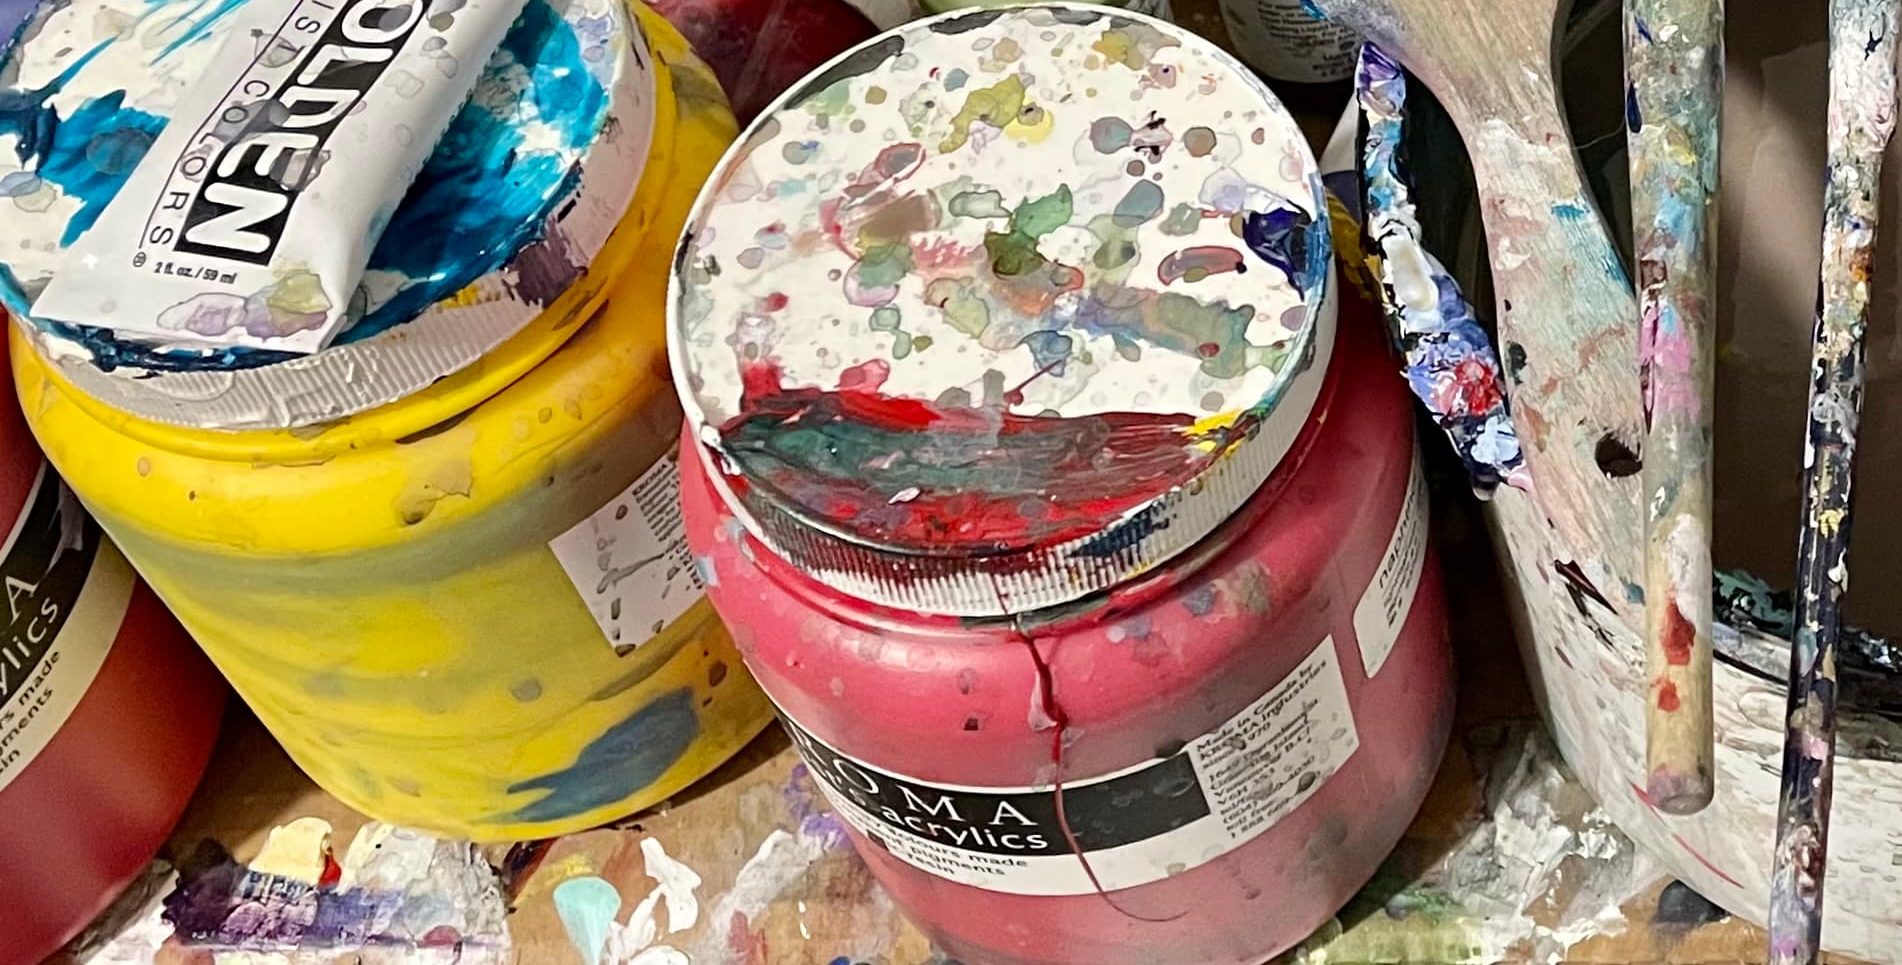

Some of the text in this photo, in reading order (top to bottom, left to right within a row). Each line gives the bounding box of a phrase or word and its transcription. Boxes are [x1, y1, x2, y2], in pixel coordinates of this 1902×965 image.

[148, 78, 271, 247] COLORS
[153, 261, 164, 274] 2
[202, 268, 219, 281] 59
[218, 272, 238, 285] ml
[0, 596, 59, 697] ylics
[18, 649, 61, 707] made
[1253, 678, 1299, 717] Canada
[0, 687, 54, 757] ments
[788, 721, 1040, 827] ROMA
[880, 804, 1049, 850] acrylics
[906, 852, 956, 877] resin
[909, 845, 1007, 877] pigments
[968, 853, 1029, 869] made
